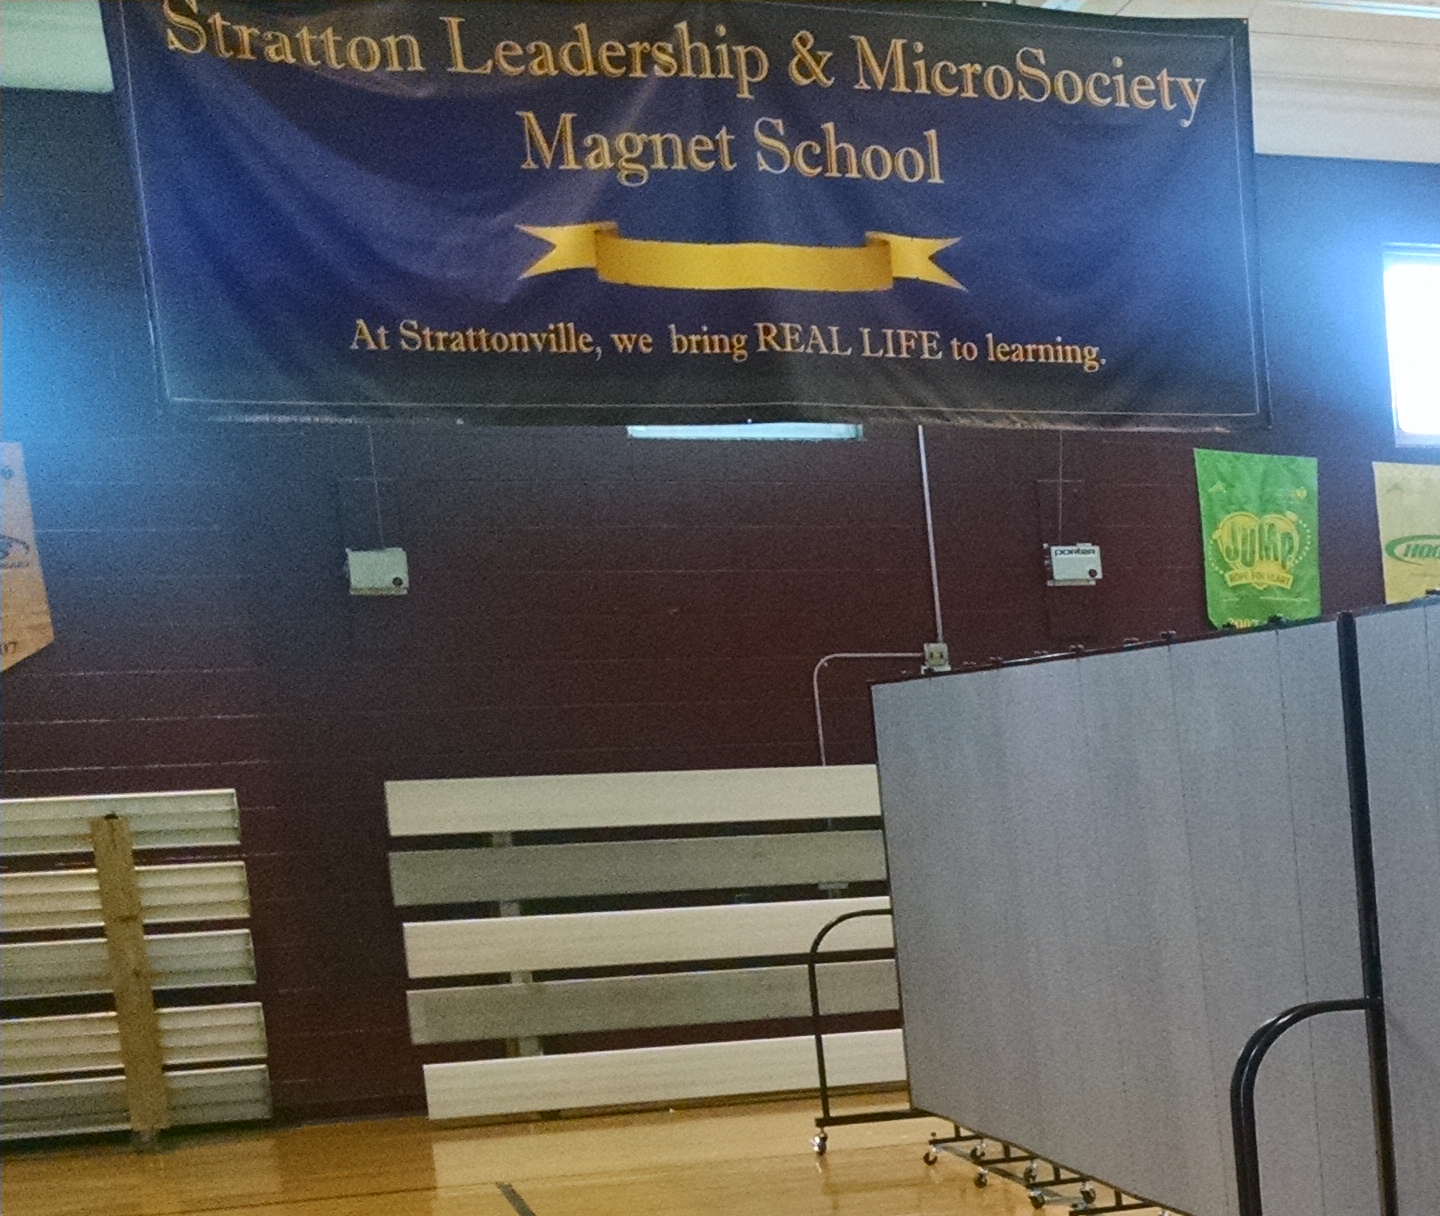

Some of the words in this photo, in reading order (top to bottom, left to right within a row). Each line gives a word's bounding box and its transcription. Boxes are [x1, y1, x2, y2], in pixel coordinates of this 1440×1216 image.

[165, 0, 426, 73] Stratton
[439, 15, 769, 99] Leadership
[787, 29, 835, 89] &
[850, 34, 1207, 128] MicroSociety
[515, 110, 737, 187] Magnet
[752, 116, 944, 184] School
[349, 318, 387, 352] At
[398, 318, 603, 361] Strattonville,
[610, 331, 654, 355] we
[669, 324, 748, 363] bring
[754, 322, 852, 357] REAL
[860, 327, 943, 361] LIFE
[950, 336, 978, 363] to
[985, 333, 1107, 374] learning.
[1224, 521, 1294, 570] JUMP
